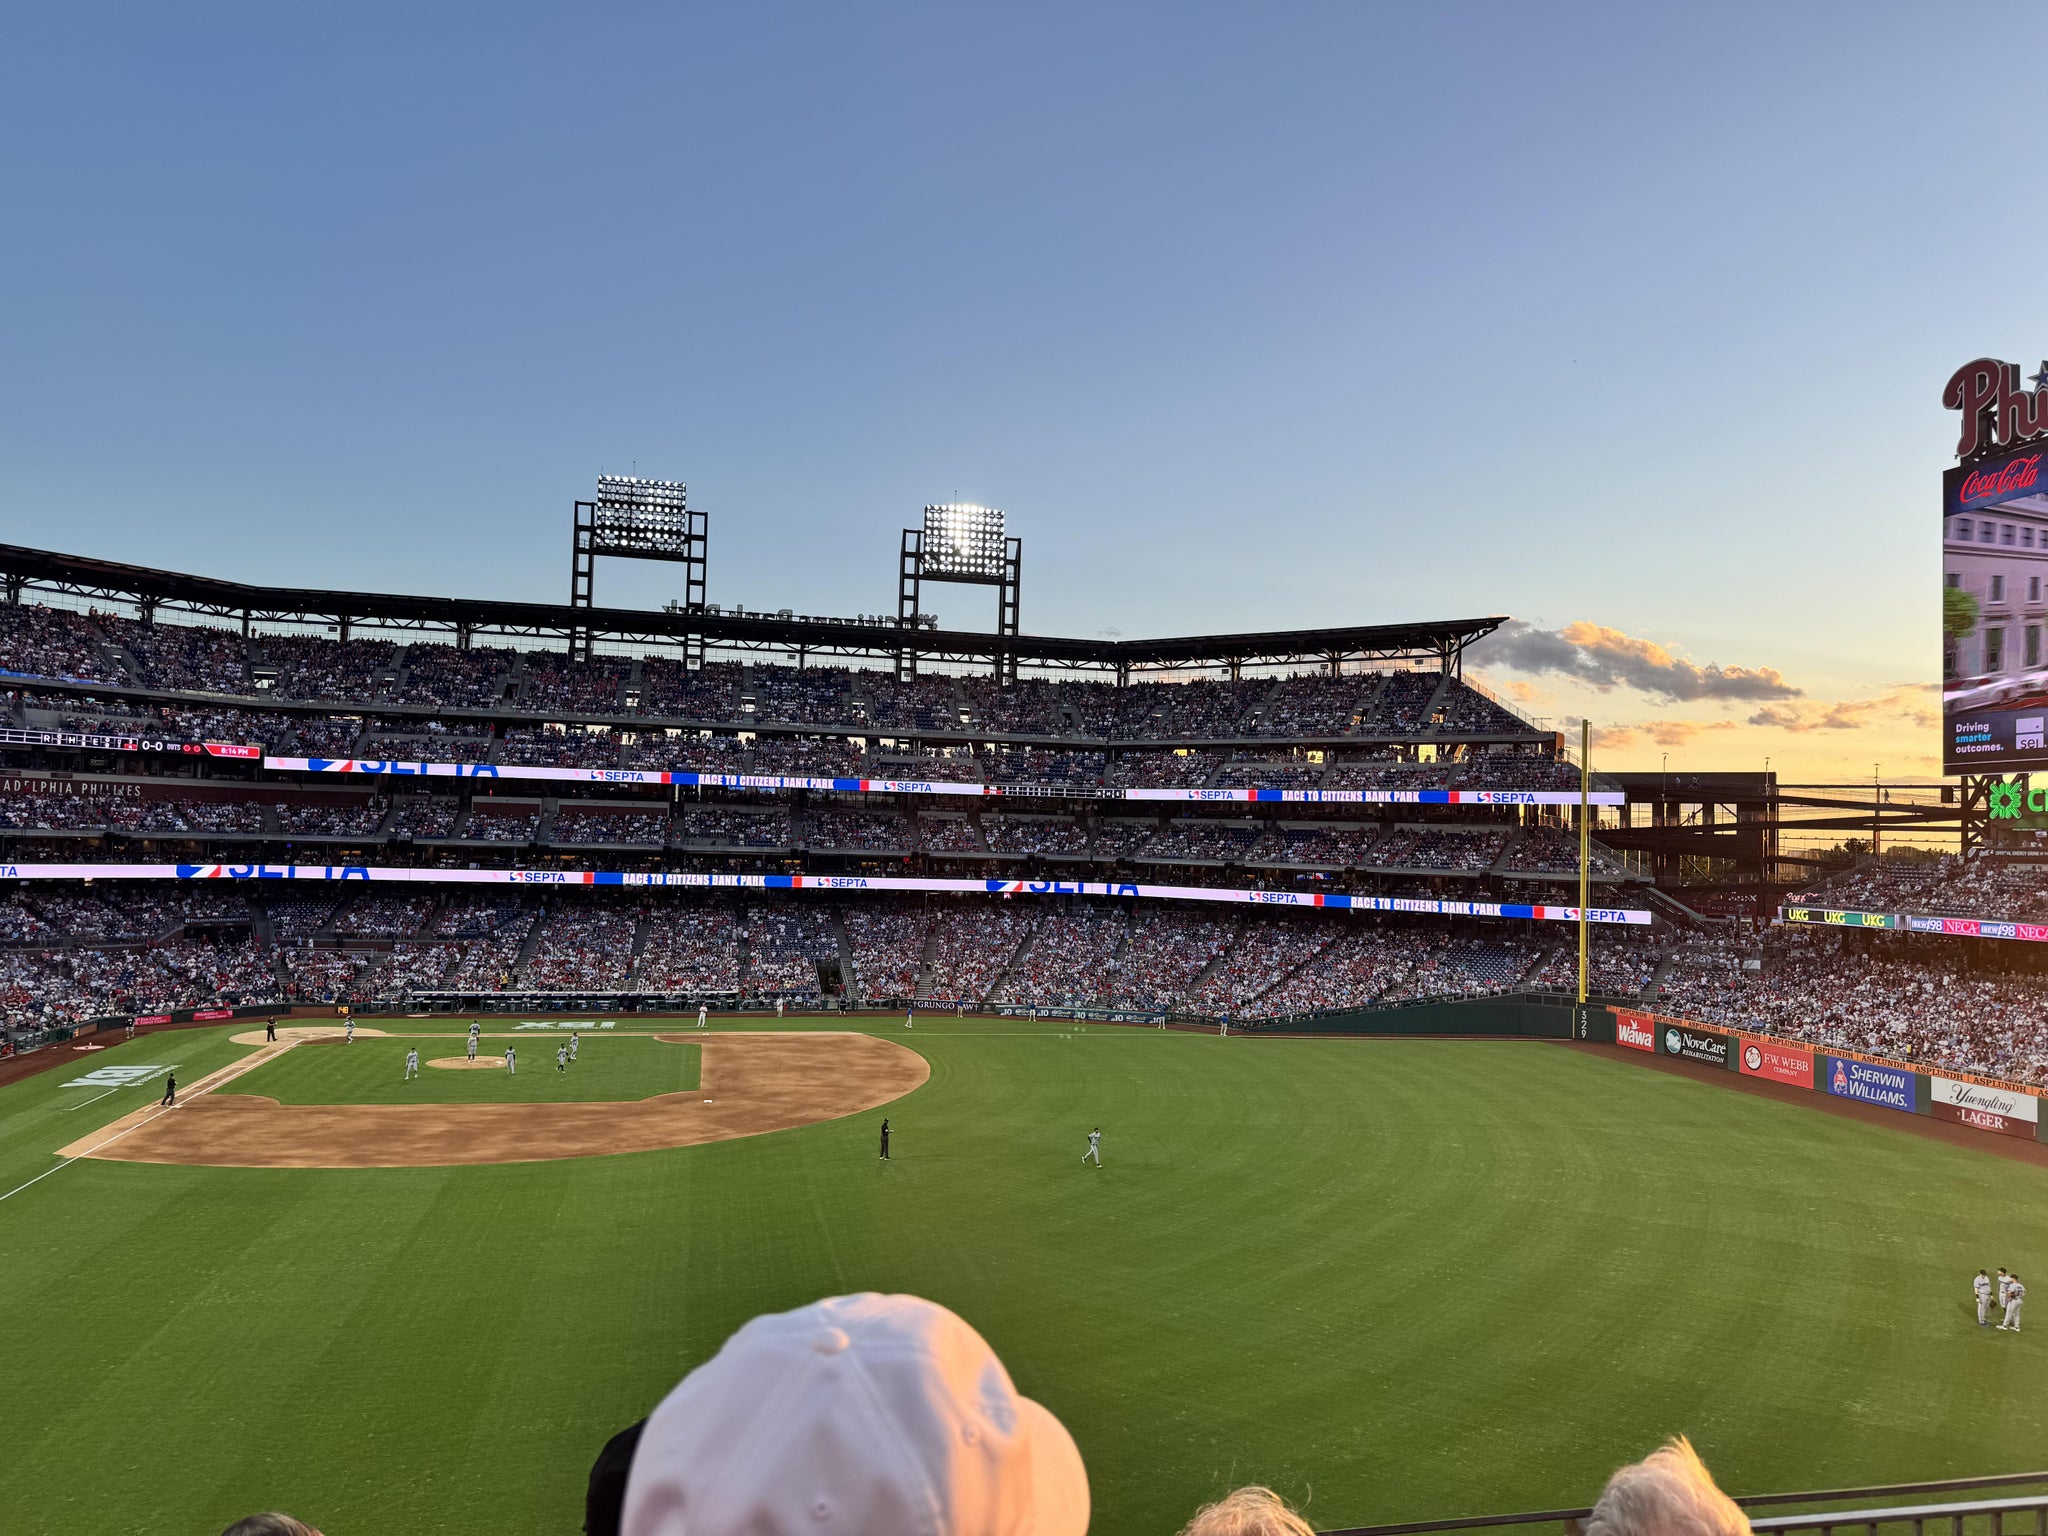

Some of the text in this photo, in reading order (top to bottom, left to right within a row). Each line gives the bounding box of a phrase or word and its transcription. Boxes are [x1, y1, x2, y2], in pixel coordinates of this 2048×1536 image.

[1955, 722, 1989, 733] Driving
[69, 736, 75, 744] H
[1955, 732, 1992, 743] smarter
[142, 741, 163, 751] 0-0
[1955, 744, 2004, 753] outcomes.
[605, 771, 644, 782] SEPTA
[699, 775, 835, 789] RACE TO CITIZENS BANK PARK
[897, 783, 932, 793] SEPTA
[1200, 790, 1234, 800] SEPTA
[1282, 790, 1420, 802] RACE TO CITIZENS BANK PARK
[1492, 793, 1535, 803] SEPTA
[525, 872, 566, 883] SEPTA
[623, 873, 766, 887] RACE TO CITIZENS BANK PARK
[831, 878, 868, 888] SEPTA
[1262, 893, 1298, 904] SEPTA
[1351, 897, 1502, 916] RACE TO CITIZENS BANK PARK
[1584, 911, 1626, 922] SEPTA
[1788, 908, 1809, 921] UKG
[1823, 911, 1846, 924] UKG
[1861, 914, 1885, 927] UKG
[1945, 921, 1980, 934] NECA
[917, 1001, 955, 1010] GRUNGO
[1687, 1020, 1721, 1033] ASPLUNDH
[1618, 1025, 1653, 1047] Wawa
[1726, 1029, 1761, 1042] ASPLUNDH
[1682, 1033, 1727, 1055] NovaCare
[1767, 1036, 1805, 1050] ASPLUNDH
[1682, 1049, 1725, 1063] REHABILITATION
[1813, 1045, 1854, 1059] ASPLUNDH
[1781, 1057, 1809, 1072] WEBB
[1861, 1055, 1906, 1070] ASPLUNDH
[1773, 1067, 1798, 1077] COMPANY
[1914, 1065, 1963, 1081] ASPLUNDH
[1973, 1076, 2027, 1093] ASPLUNDH
[1949, 1083, 2016, 1114] Yuengling
[1961, 1109, 2004, 1130] LAGER
